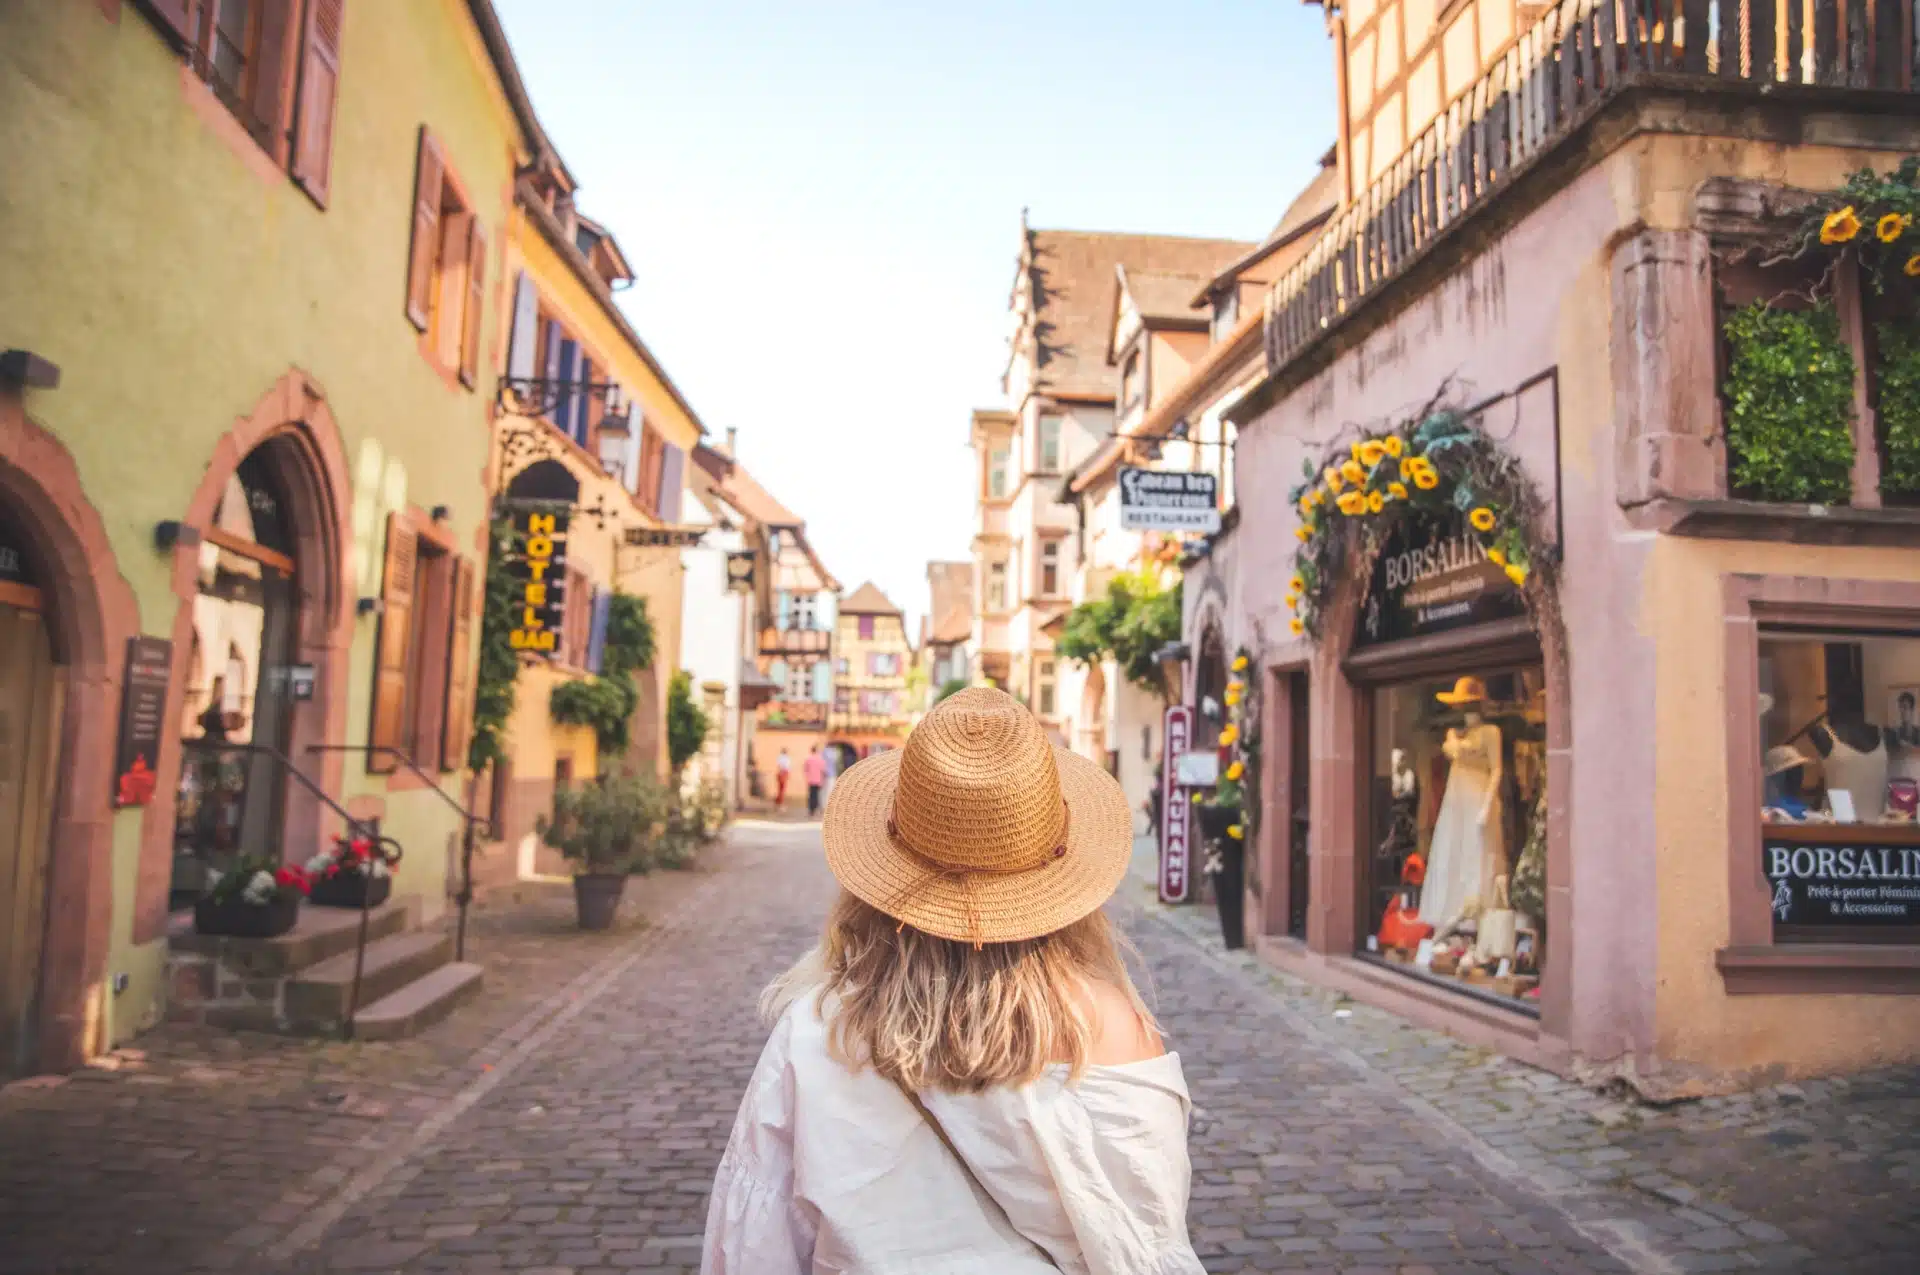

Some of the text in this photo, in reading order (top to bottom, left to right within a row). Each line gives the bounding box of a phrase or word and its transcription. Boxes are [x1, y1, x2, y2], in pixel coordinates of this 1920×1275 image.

[1128, 513, 1209, 523] RESTAURANT
[524, 512, 556, 627] HOTEL
[1386, 532, 1489, 590] BORSALIN
[509, 628, 555, 650] BAR
[1168, 721, 1185, 887] REAURANT
[1879, 884, 1920, 898] Fémini
